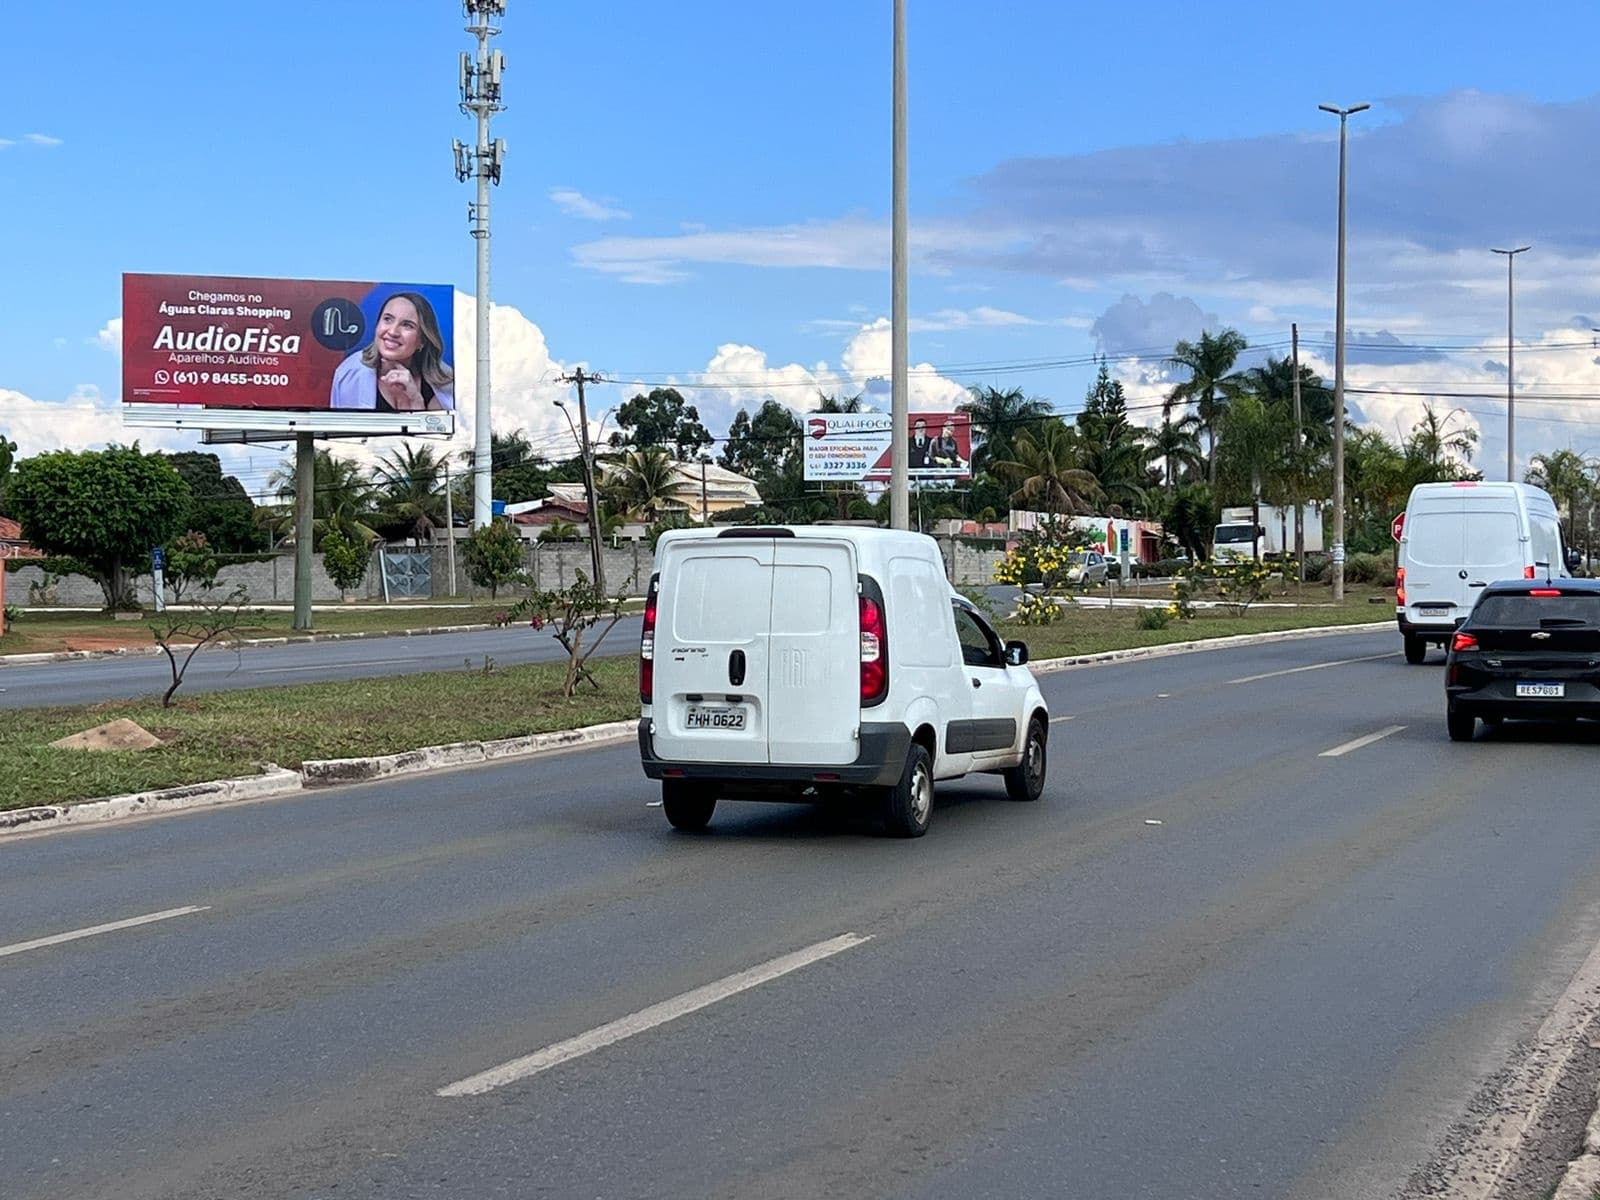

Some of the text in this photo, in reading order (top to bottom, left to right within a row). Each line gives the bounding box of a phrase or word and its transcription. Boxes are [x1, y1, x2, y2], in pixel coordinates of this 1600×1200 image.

[188, 290, 262, 304] Chegamos no
[159, 301, 291, 320] Águas Claras Shopping
[153, 325, 301, 354] AudioFisa
[168, 353, 279, 366] Aparelhos Auditivos
[173, 371, 289, 386] (61) 9 8455-0300
[824, 461, 844, 469] 3327
[846, 461, 867, 469] 3336
